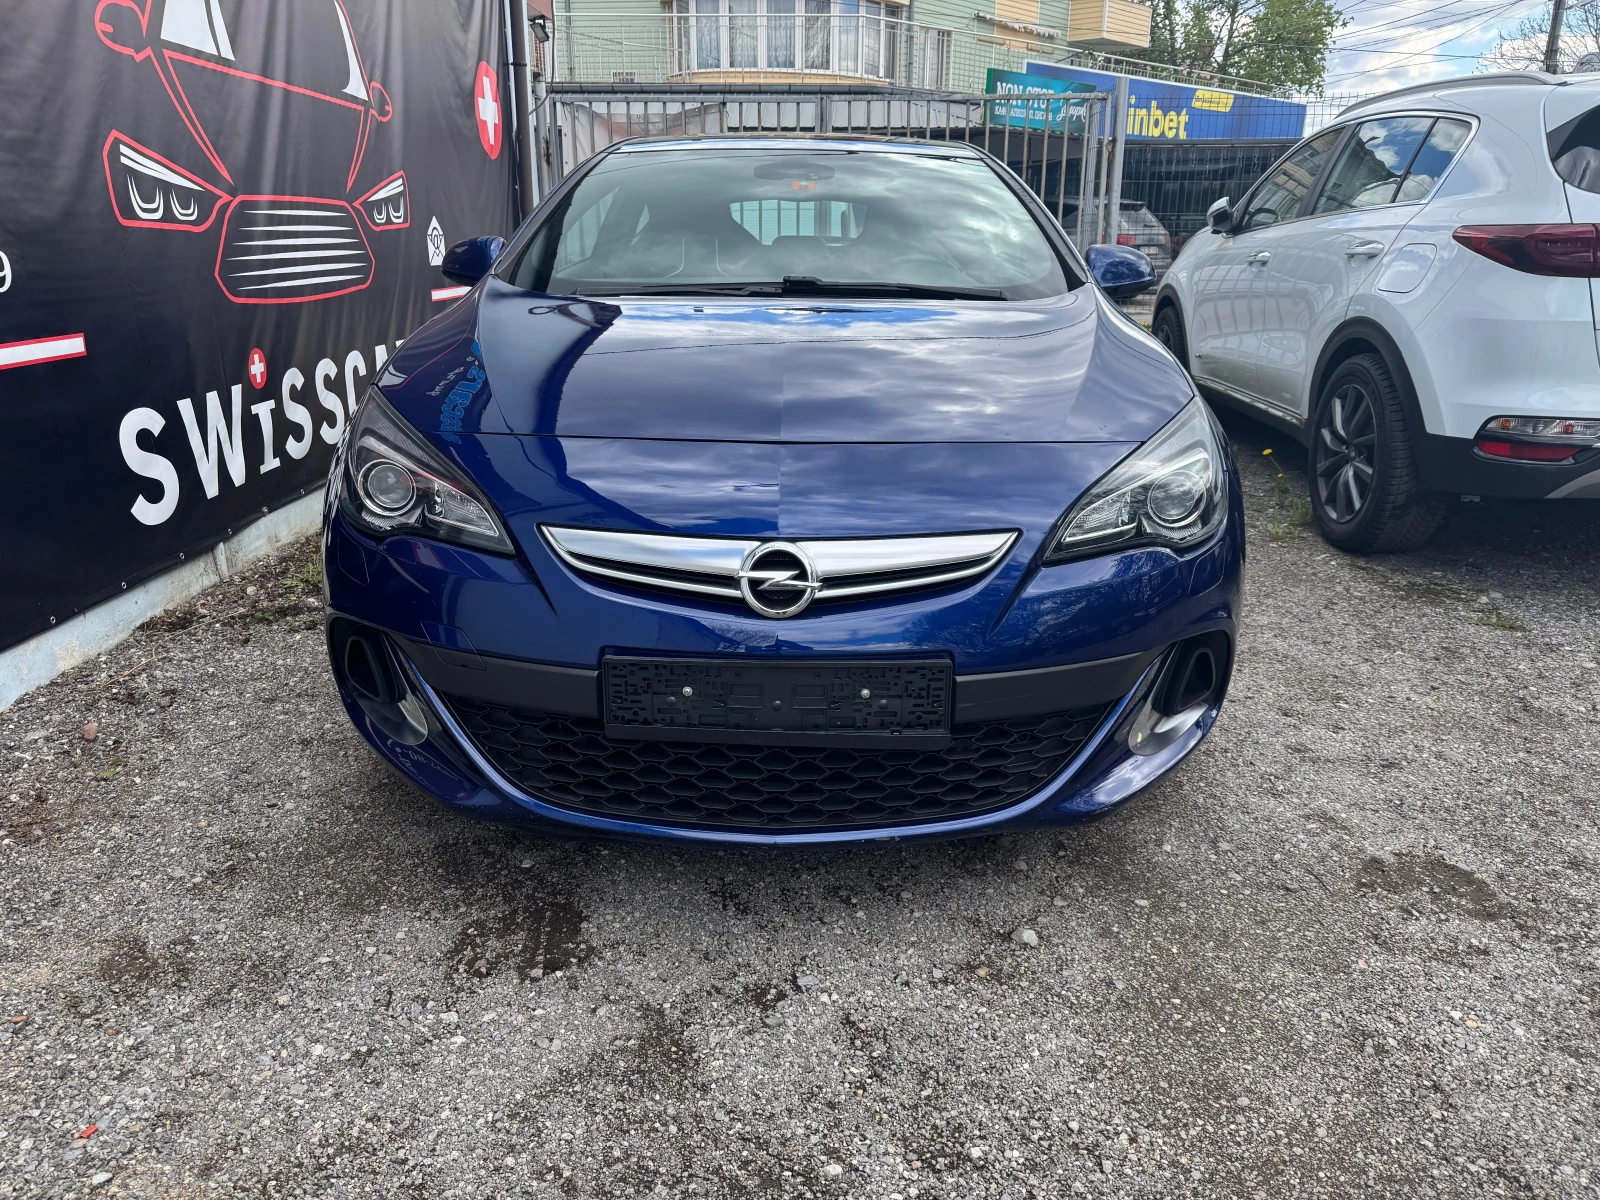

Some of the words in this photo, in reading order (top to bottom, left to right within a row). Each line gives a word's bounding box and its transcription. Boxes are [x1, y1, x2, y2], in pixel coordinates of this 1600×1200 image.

[995, 82, 1023, 106] NON
[1025, 86, 1054, 109] STOP
[994, 105, 1009, 116] КАФ
[1010, 107, 1034, 119] АЛКОХЛ
[1127, 94, 1189, 139] inbet
